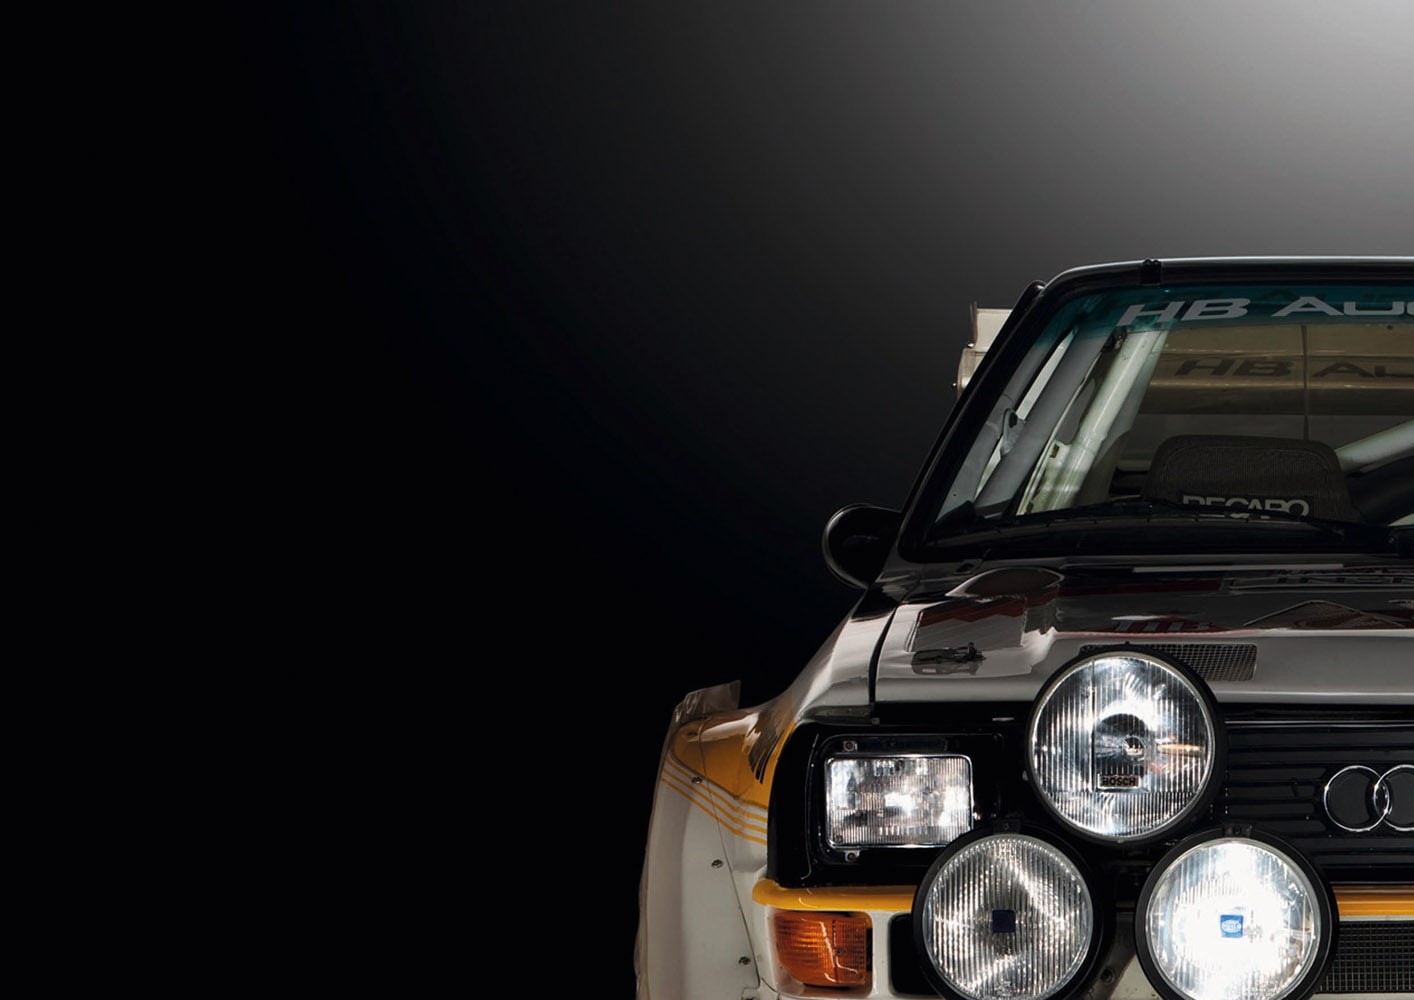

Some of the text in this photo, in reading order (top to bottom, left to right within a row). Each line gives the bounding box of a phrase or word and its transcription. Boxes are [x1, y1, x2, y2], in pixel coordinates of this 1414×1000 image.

[1116, 298, 1251, 326] HB
[1174, 359, 1295, 377] HB
[1102, 776, 1136, 786] BOSCH
